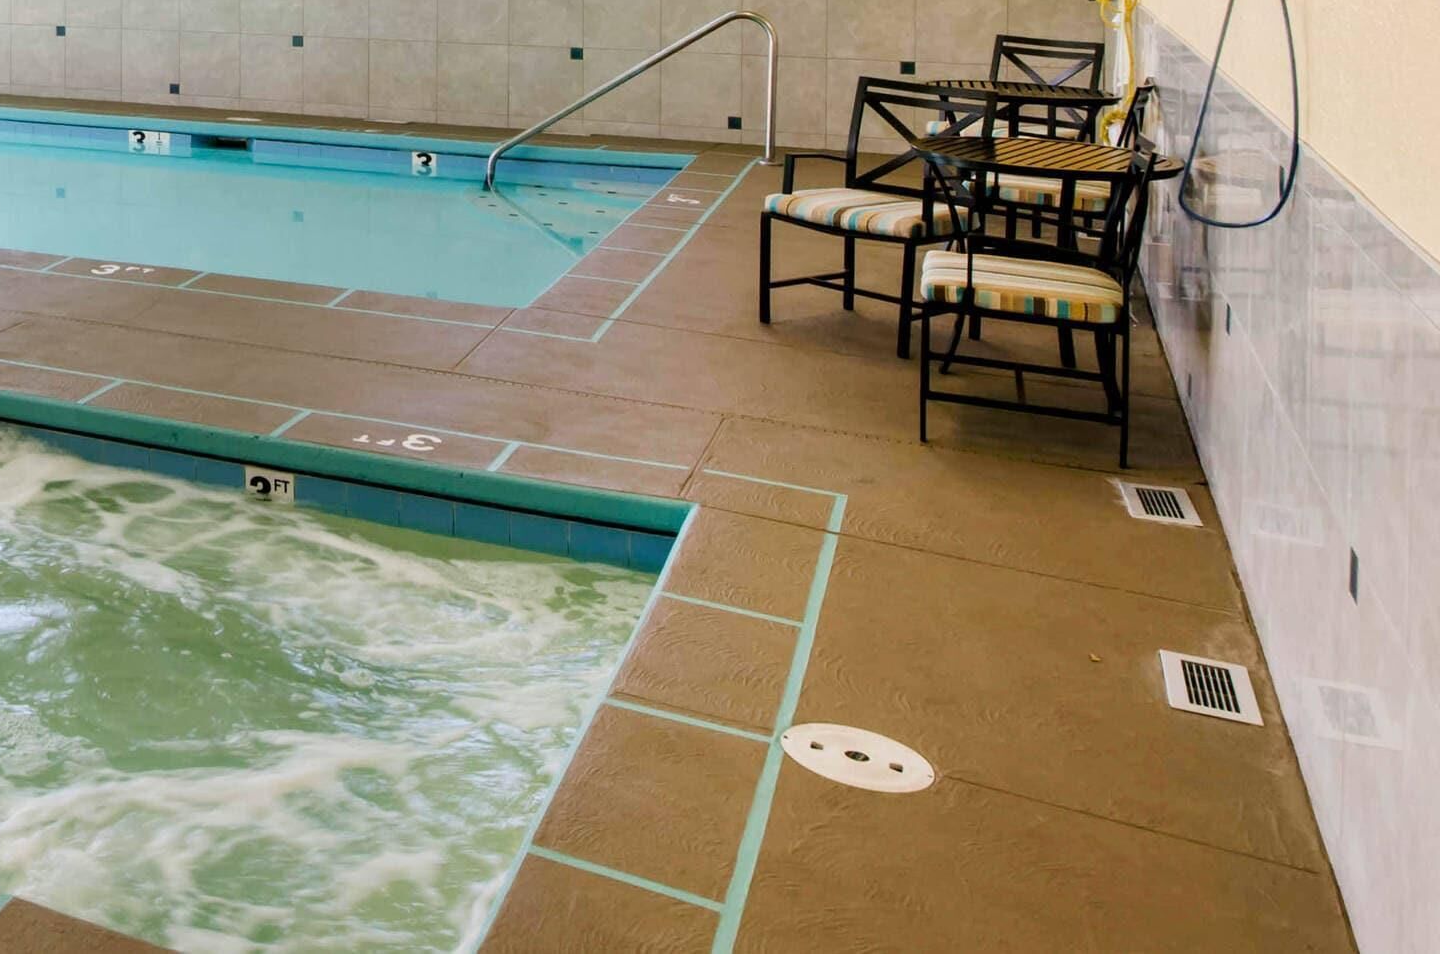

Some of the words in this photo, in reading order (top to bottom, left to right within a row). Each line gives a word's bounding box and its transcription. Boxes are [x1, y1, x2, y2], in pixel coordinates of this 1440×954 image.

[90, 264, 121, 275] 3
[352, 434, 396, 446] FT
[402, 433, 442, 451] 3
[274, 478, 290, 493] FT
